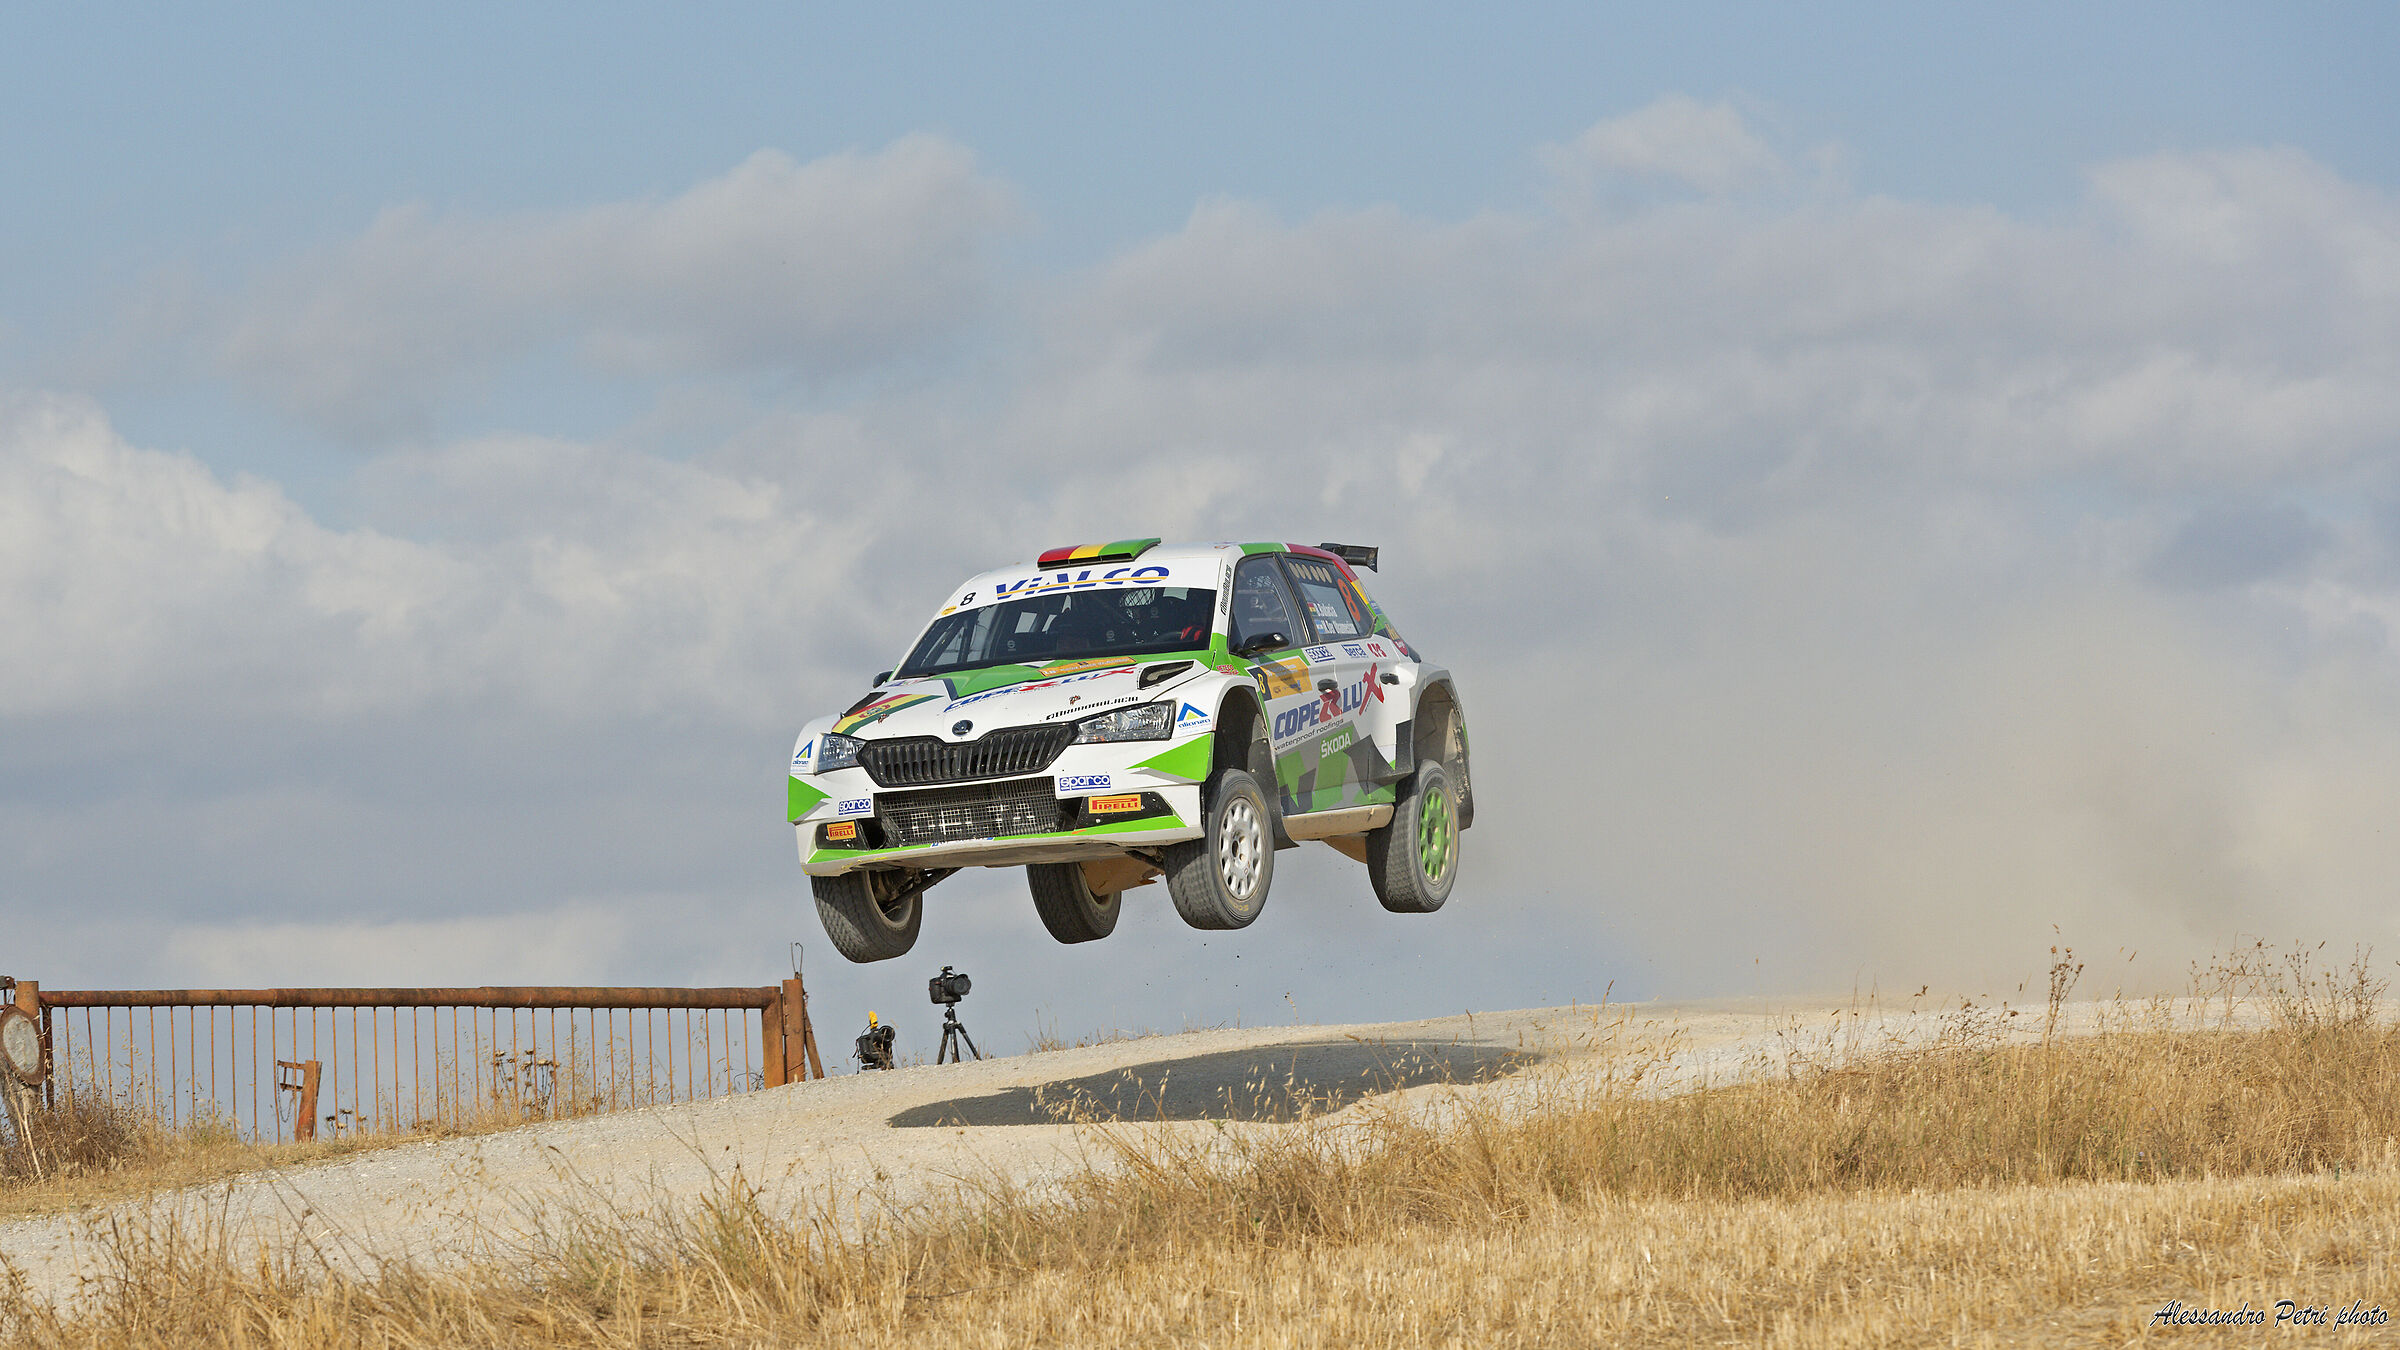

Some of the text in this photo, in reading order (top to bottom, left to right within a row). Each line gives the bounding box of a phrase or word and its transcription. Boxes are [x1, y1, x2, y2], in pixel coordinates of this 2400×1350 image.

[959, 592, 977, 606] 8
[1336, 577, 1361, 623] 8
[1257, 673, 1267, 695] 8
[1274, 662, 1385, 740] COPERLUX
[1275, 719, 1344, 752] waterproof roofings
[1321, 732, 1352, 758] ŠKODA
[1060, 774, 1111, 790] sparco
[839, 800, 871, 815] sparco
[1092, 797, 1139, 810] PIRELLI
[828, 824, 855, 838] PIRELLI
